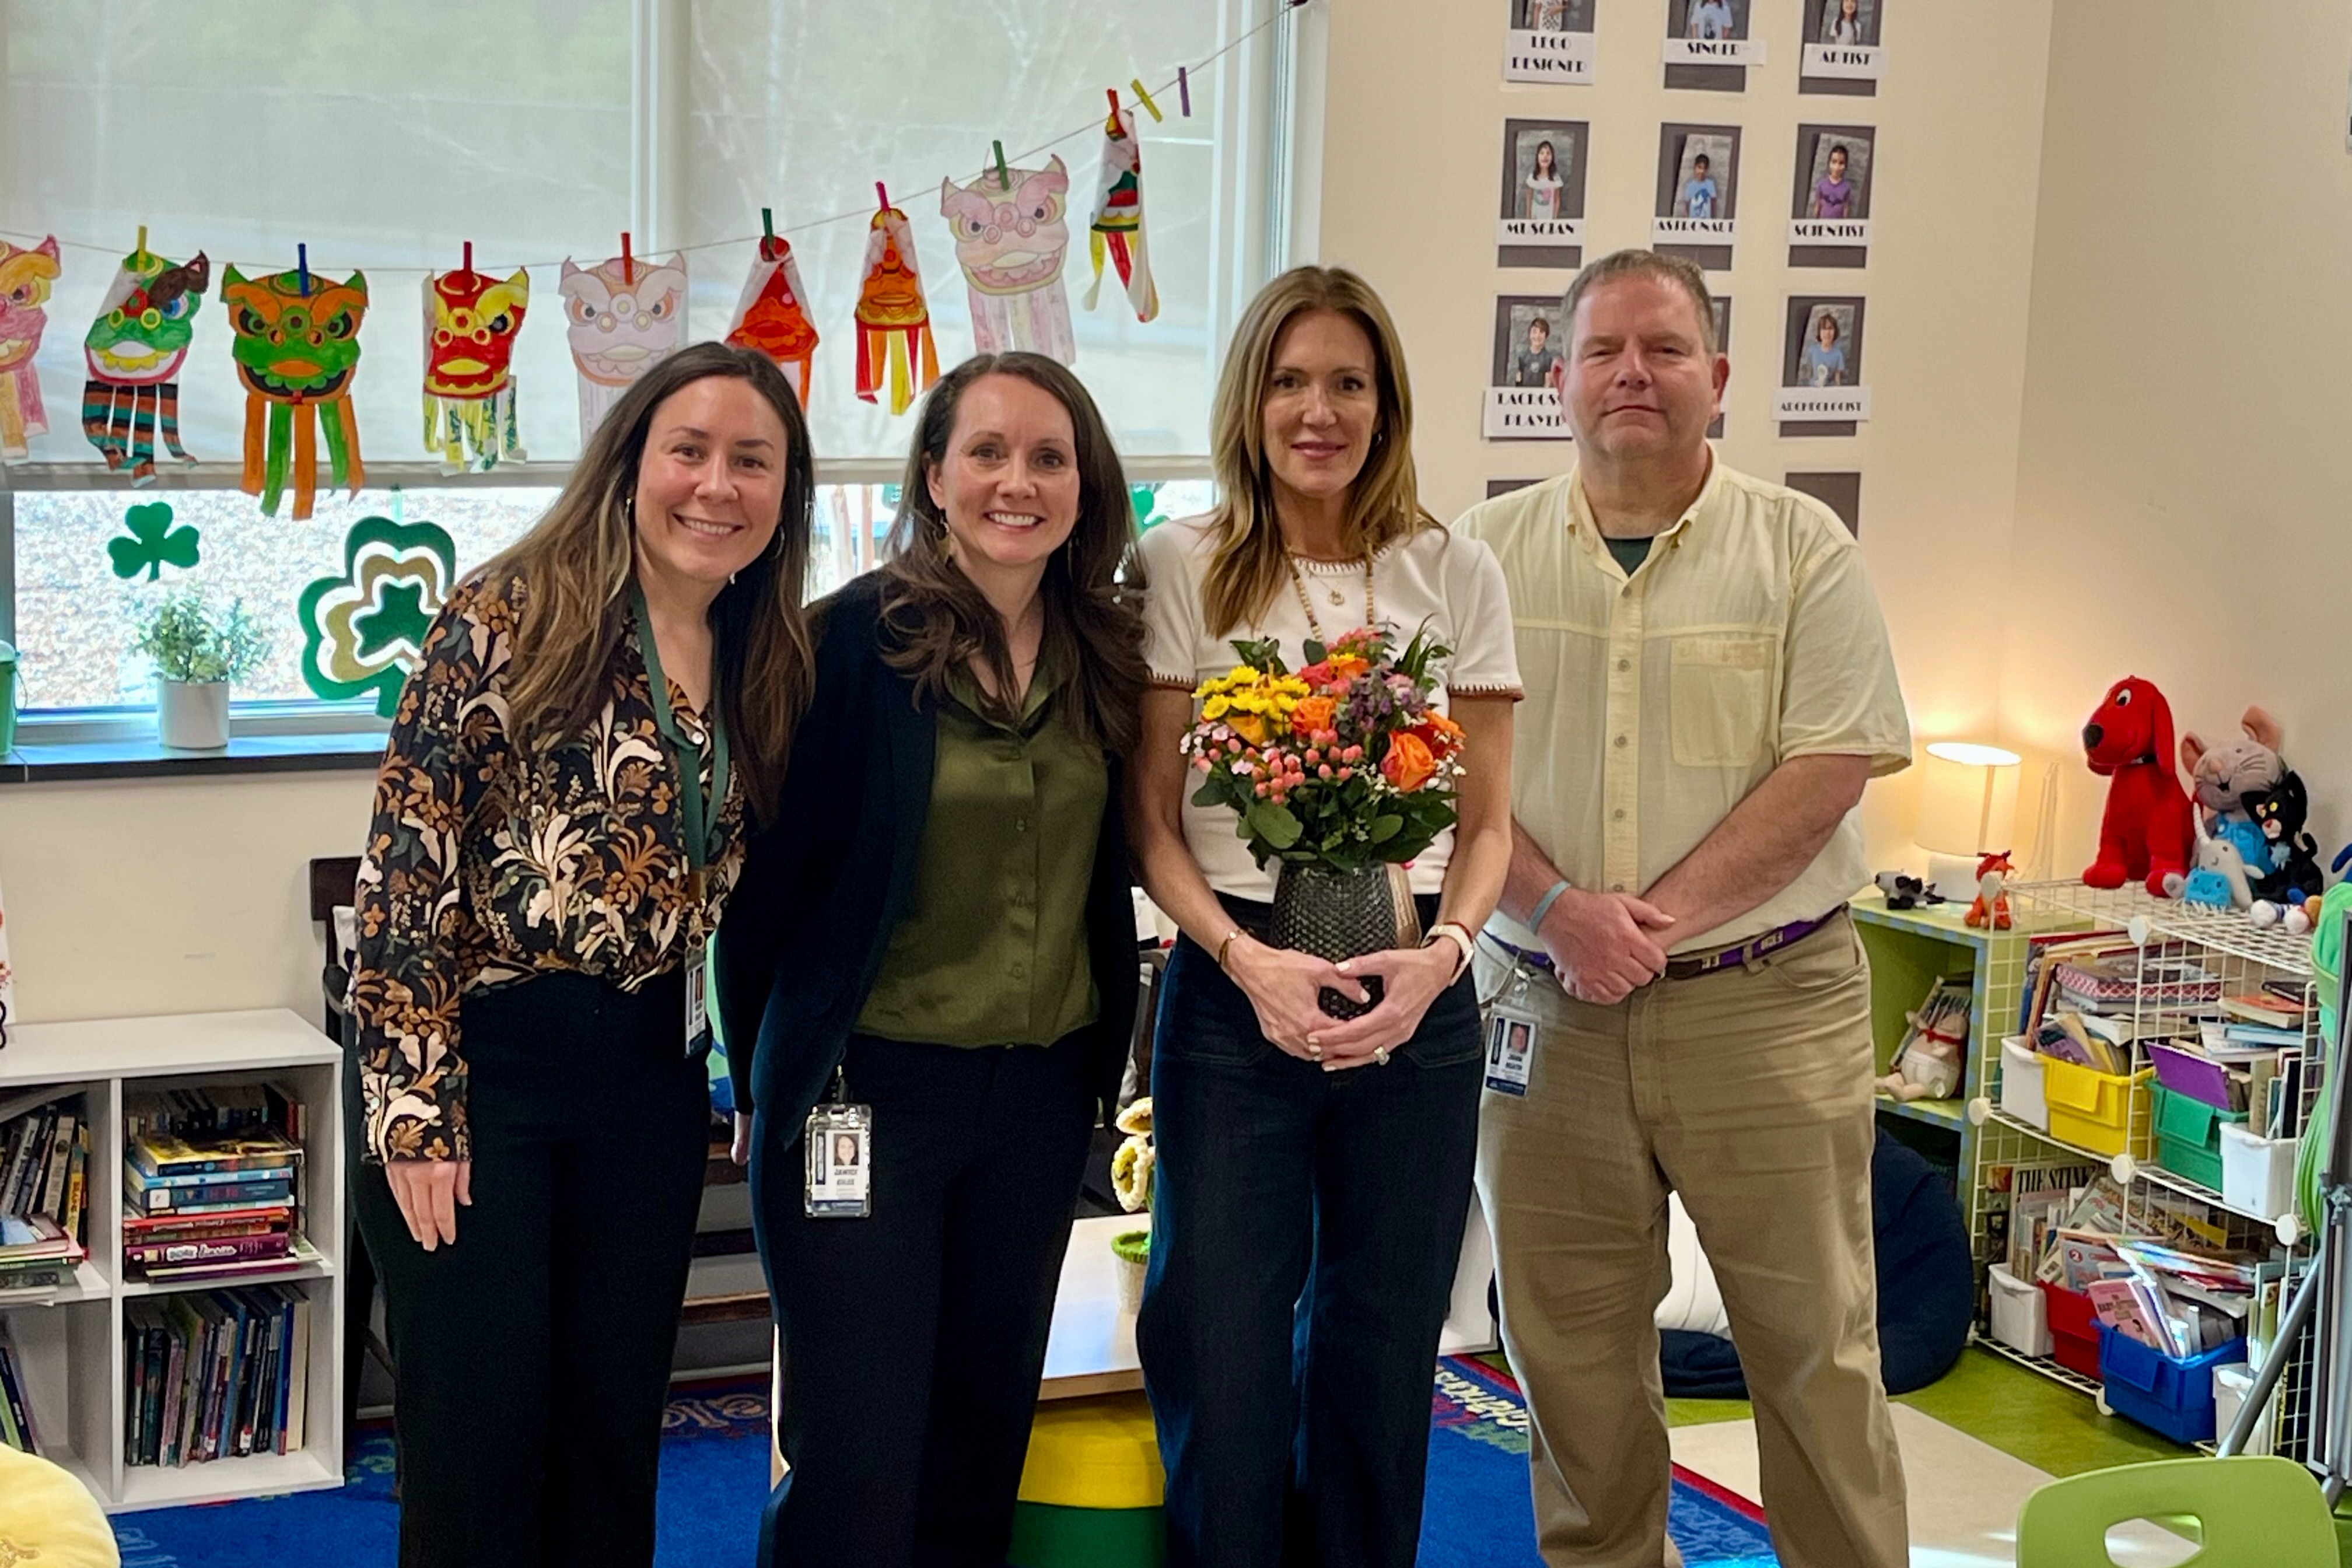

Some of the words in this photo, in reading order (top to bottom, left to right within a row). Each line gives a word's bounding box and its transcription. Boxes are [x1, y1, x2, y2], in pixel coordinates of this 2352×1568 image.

[1531, 36, 1572, 50] LEGO
[1686, 41, 1740, 56] SINGER
[1512, 57, 1588, 73] DESIGNER
[1821, 51, 1871, 65] ARTIST
[1506, 222, 1574, 235] MUSCIAN
[1656, 220, 1734, 233] ASTRONAUT
[1794, 224, 1866, 237] SCIENTIST
[1497, 392, 1558, 406] LACROS
[2017, 1168, 2043, 1195] THE
